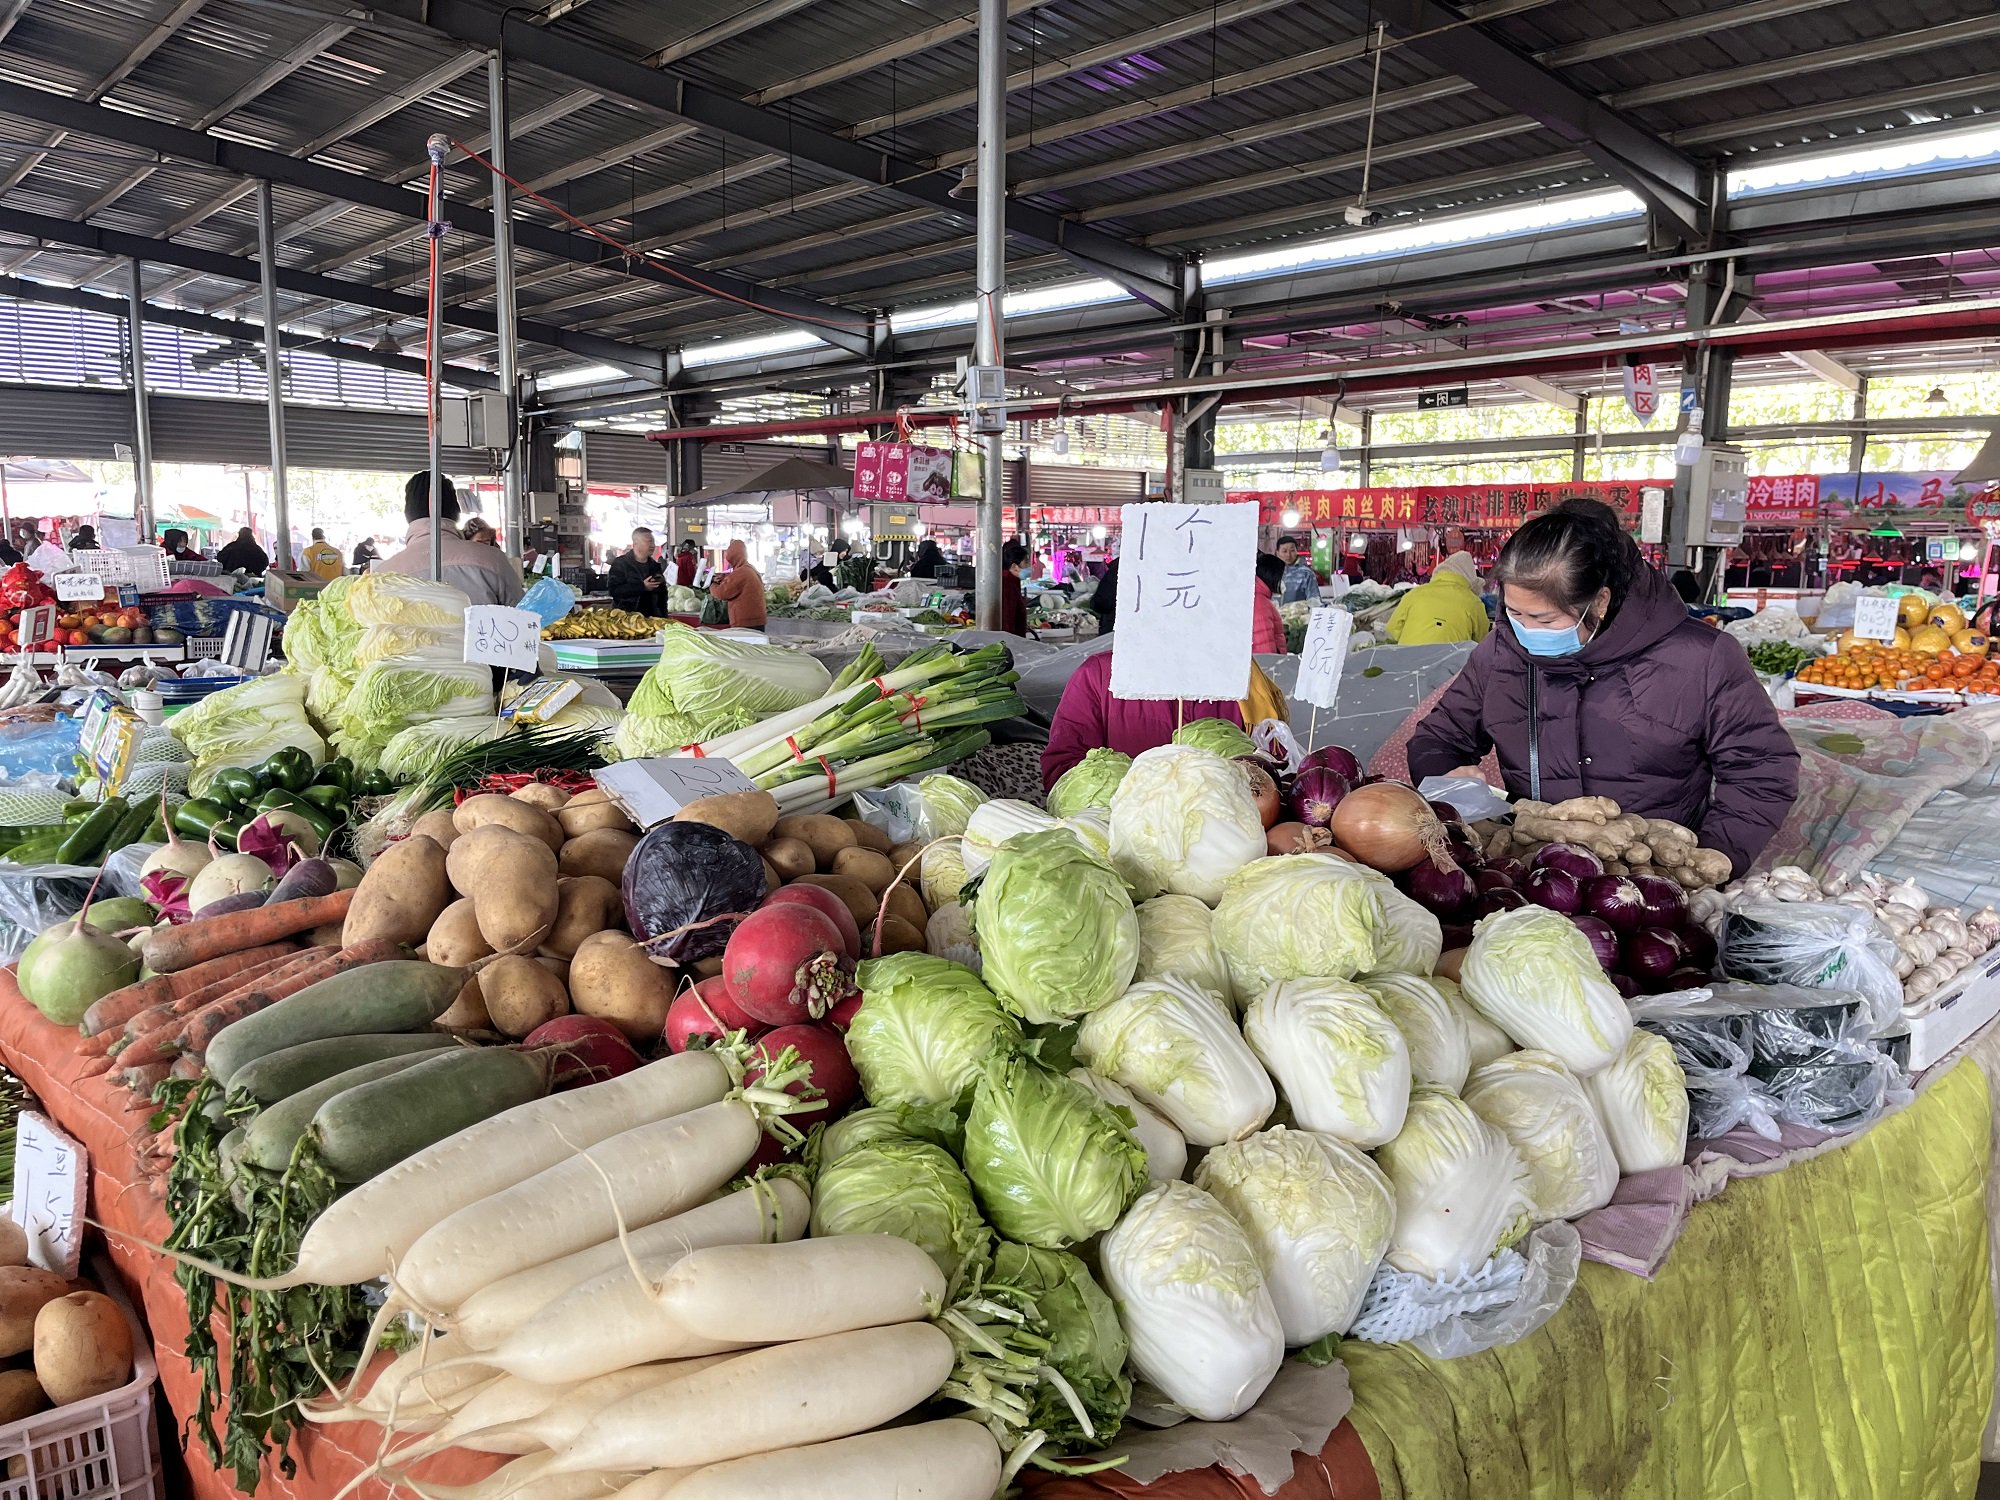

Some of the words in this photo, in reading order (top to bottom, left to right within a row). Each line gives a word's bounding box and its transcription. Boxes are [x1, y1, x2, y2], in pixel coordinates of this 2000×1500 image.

[1633, 365, 1654, 414] 肉区
[1746, 478, 1816, 507] 冷鲜肉
[1134, 568, 1201, 613] 1元
